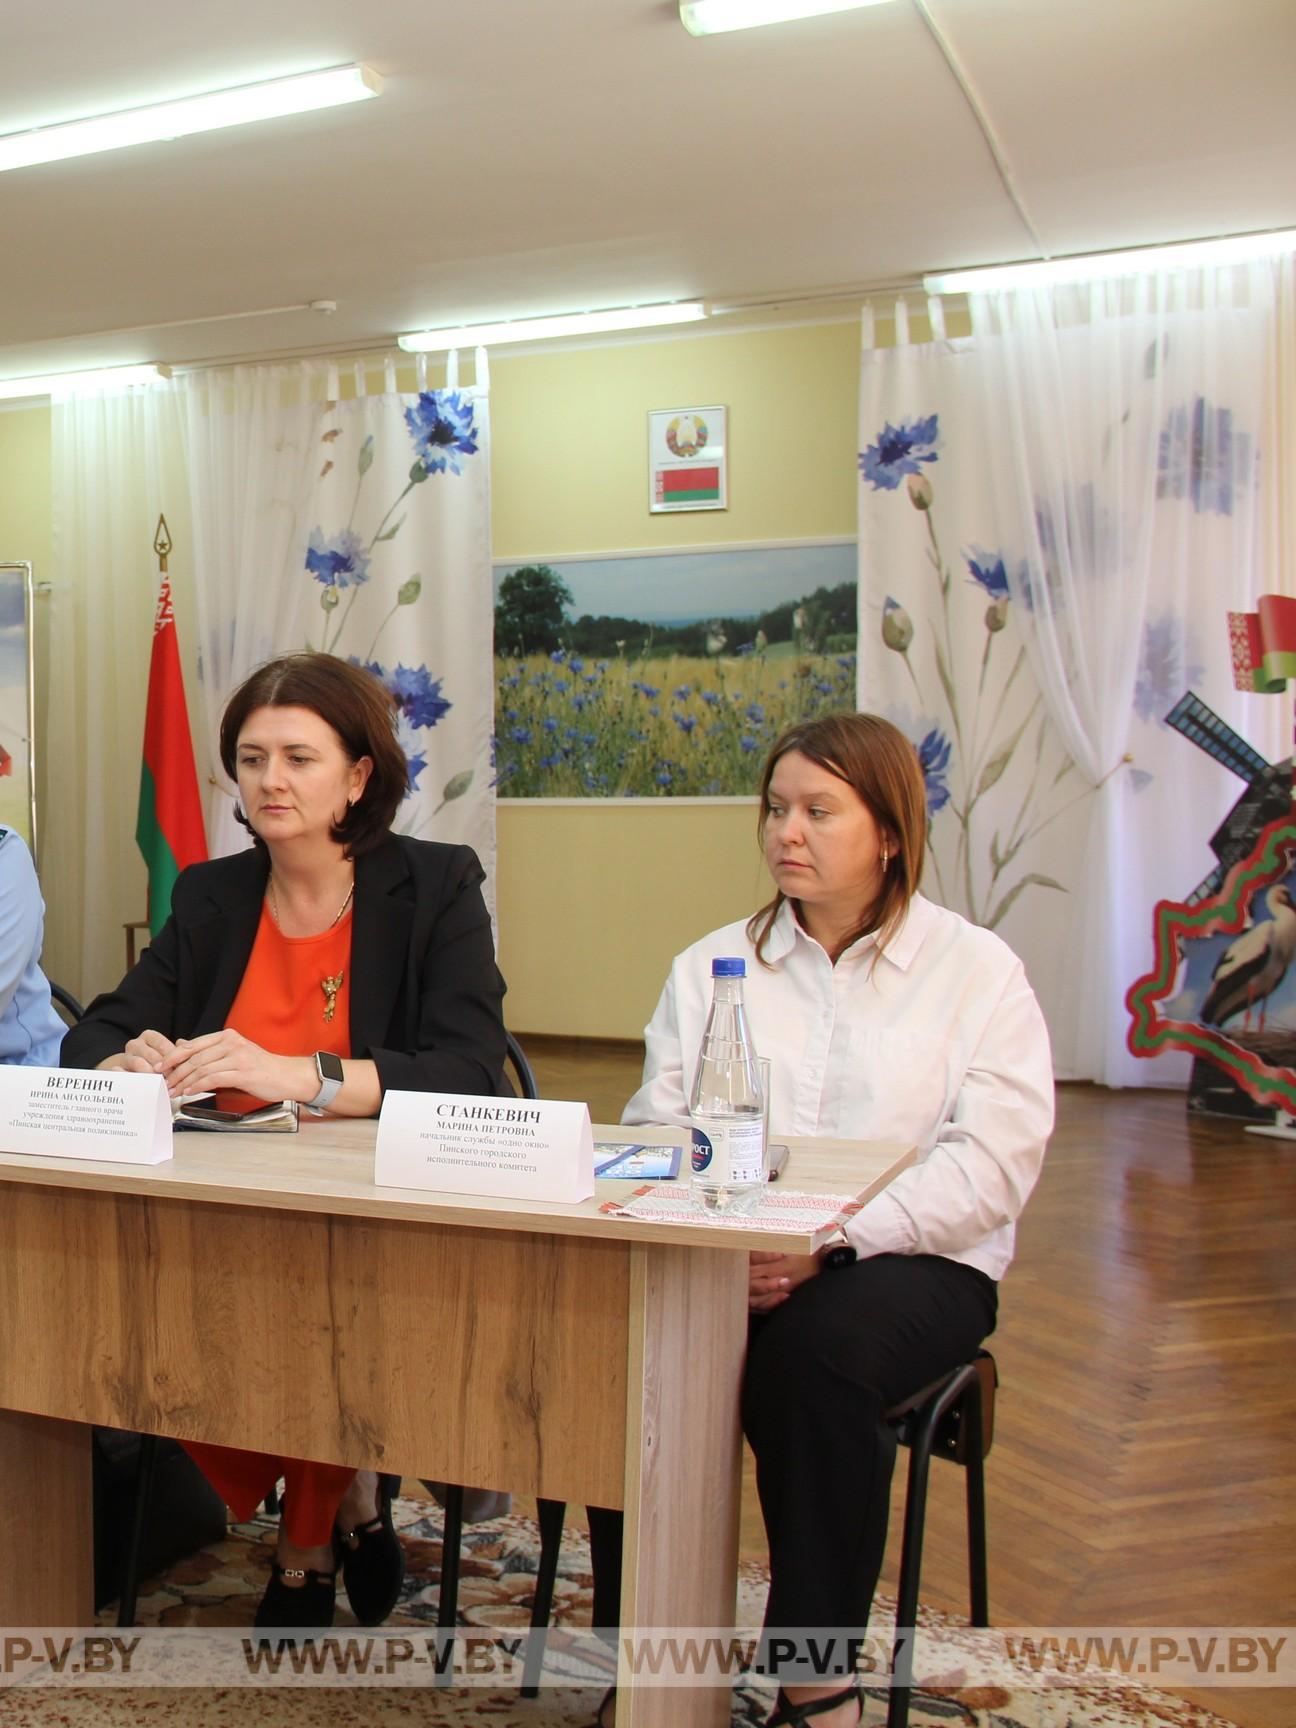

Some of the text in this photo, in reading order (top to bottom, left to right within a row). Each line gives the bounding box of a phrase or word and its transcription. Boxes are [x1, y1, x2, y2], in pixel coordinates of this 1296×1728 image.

[46, 1076, 114, 1092] ВЕРЕНИЧ
[29, 1090, 125, 1105] ИРИНА АНАТОЛЬЕВНА
[28, 1101, 124, 1116] заместитель главного врача
[436, 1103, 541, 1123] СТАНКЕВИЧ
[23, 1111, 126, 1126] учреждения здравоохранения
[9, 1119, 138, 1138] «Пинская центральная поликлиника»
[436, 1120, 536, 1137] МАРИНА ПЕТРОВНА
[420, 1131, 550, 1150] начальник службы «одно окно»
[439, 1143, 527, 1160] Пинского городского
[426, 1155, 537, 1173] исполнительного комитета
